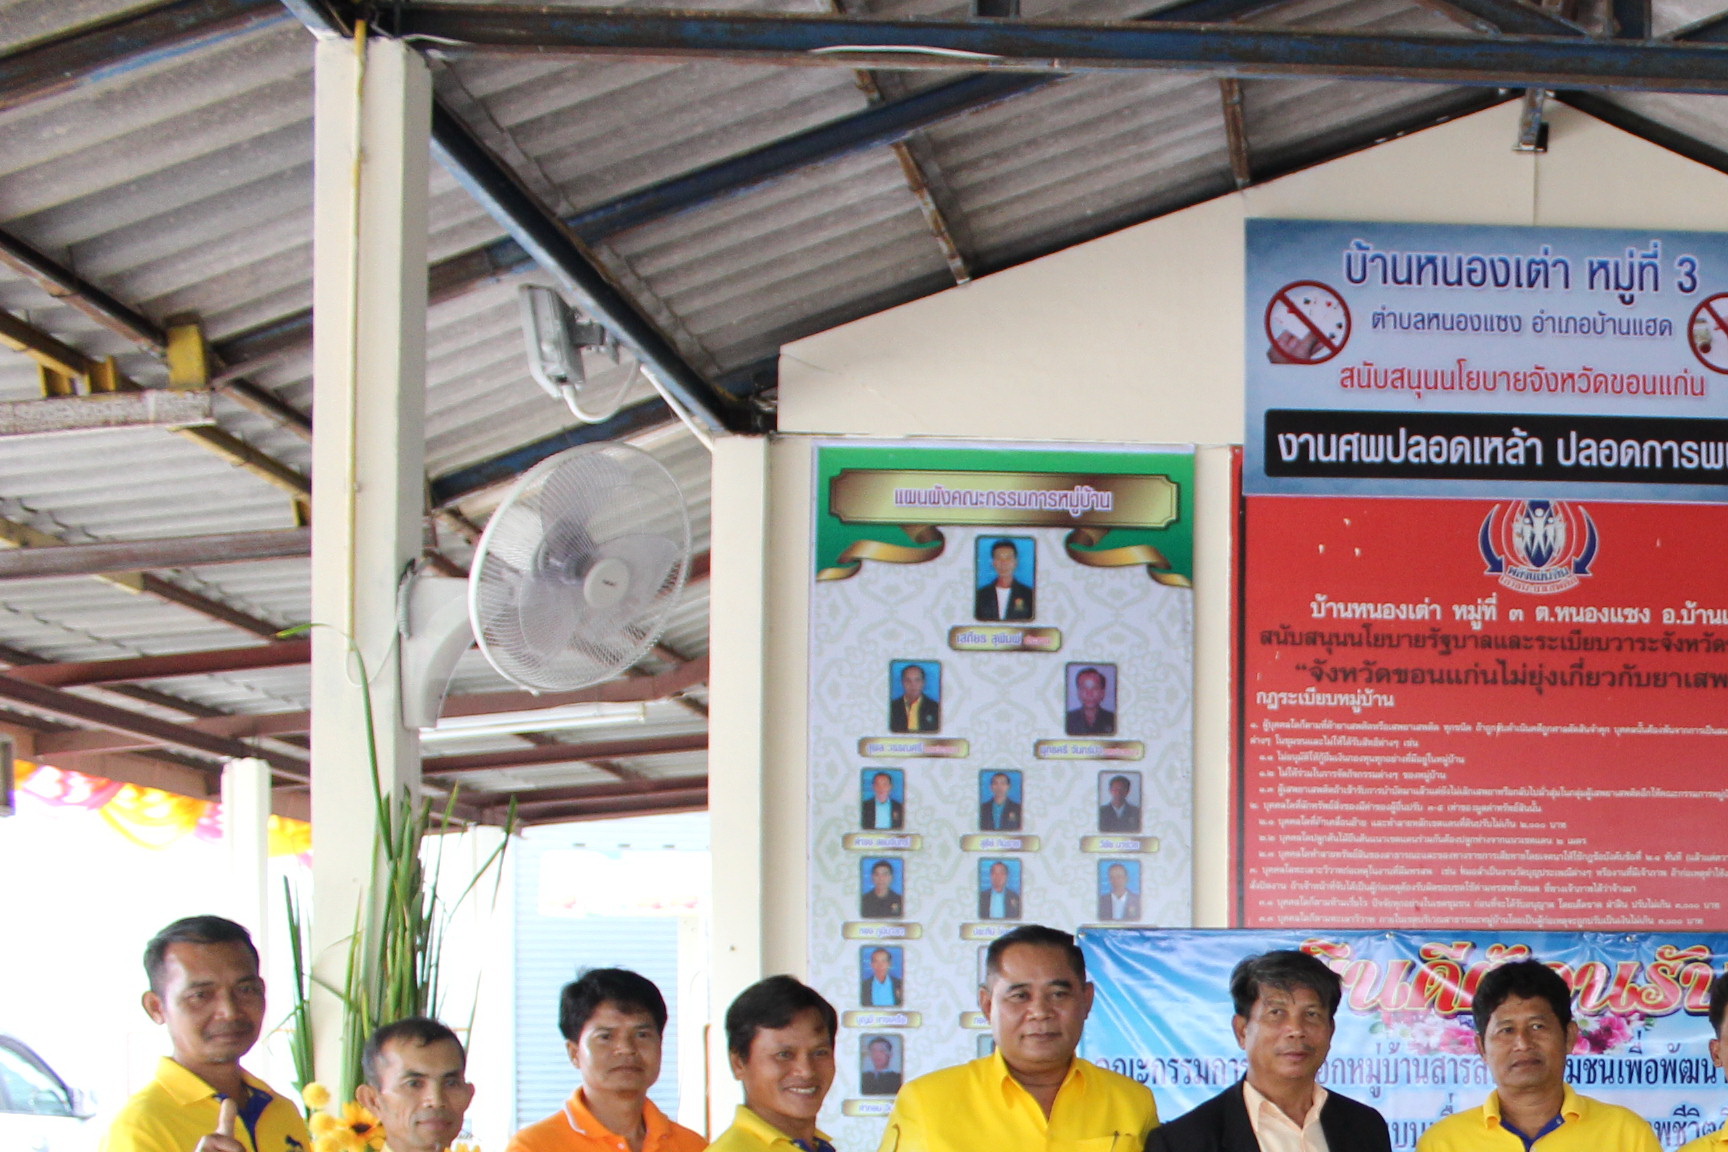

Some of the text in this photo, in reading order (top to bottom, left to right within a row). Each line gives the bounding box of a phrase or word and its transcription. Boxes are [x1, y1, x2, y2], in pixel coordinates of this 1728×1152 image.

[1343, 239, 1698, 304] บ้านหนองเต่า หมู่ที่ 3
[1371, 305, 1673, 338] ตำบลหนองแซง อำเภอบ้านแฮด
[1339, 358, 1705, 398] สนับสนุนนโยบายจังหวัดขอนแก่น
[1277, 426, 1543, 468] งานศพปลอดเหล้า
[894, 486, 1112, 517] แผนผังคณะกรรมการหมู่บ้าน
[1310, 594, 1441, 622] บ้านหนองเต่า
[1452, 592, 1497, 632] หมู่ที่
[1508, 607, 1524, 621] ๓
[1535, 605, 1650, 626] ต.หนองแซง
[1256, 687, 1394, 714] กฎระเบียบหมู่บ้าน
